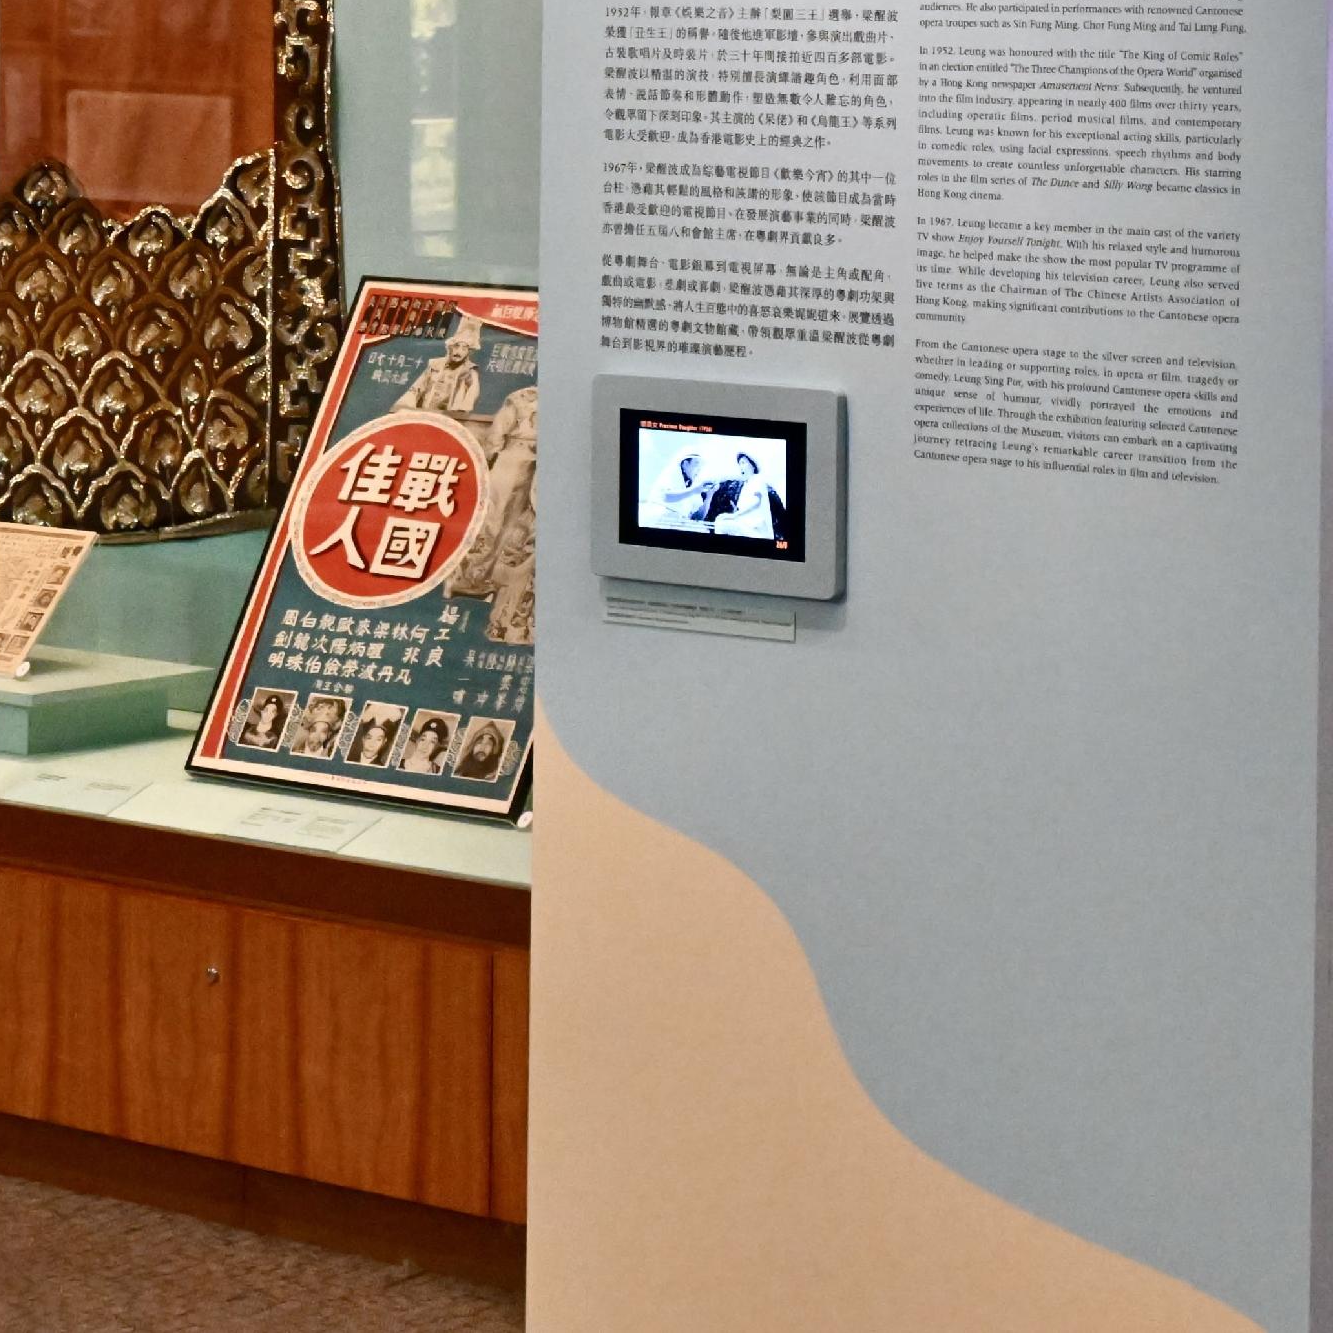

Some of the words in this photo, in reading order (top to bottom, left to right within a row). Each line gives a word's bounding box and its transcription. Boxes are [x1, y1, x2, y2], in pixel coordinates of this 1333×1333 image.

[919, 43, 928, 56] In
[958, 44, 986, 59] Leung
[988, 47, 1005, 57] was
[1008, 45, 1053, 58] honoured
[1056, 45, 1077, 58] with
[1079, 46, 1095, 59] the
[1098, 46, 1115, 59] title
[1143, 47, 1164, 62] King
[1167, 47, 1177, 60] of
[1180, 47, 1210, 60] Comic
[918, 91, 936, 104] into
[938, 91, 953, 104] the
[955, 92, 973, 105] film
[1017, 94, 1062, 110] appearing
[1065, 95, 1074, 108] in
[1077, 95, 1106, 111] nearly
[1108, 96, 1126, 109] 400
[1129, 97, 1152, 110] films
[1154, 101, 1176, 110] over
[1179, 98, 1207, 114] thirty
[917, 229, 929, 242] TV
[931, 230, 955, 243] show
[957, 231, 984, 247] Enjoy
[987, 232, 1024, 247] Yourself
[1066, 236, 1088, 250] With
[1091, 238, 1105, 251] his
[1108, 239, 1142, 253] relaxed
[1145, 240, 1167, 257] style
[1169, 242, 1187, 255] and
[915, 277, 932, 290] five
[936, 278, 963, 292] terms
[966, 282, 976, 292] as
[980, 280, 995, 293] the
[999, 281, 1047, 296] Chairman
[1051, 284, 1061, 297] of
[1064, 285, 1082, 298] The
[1087, 286, 1126, 301] Chinese
[1130, 288, 1162, 303] Artists
[1167, 290, 1224, 306] Association
[1229, 294, 1239, 307] of
[915, 336, 939, 350] From
[942, 338, 957, 351] the
[961, 339, 1009, 355] Cantonese
[1012, 345, 1038, 359] opera
[1042, 345, 1066, 361] stage
[1069, 347, 1078, 360] to
[1082, 347, 1098, 361] the
[1101, 349, 1128, 363] silver
[1131, 353, 1162, 365] screen
[1165, 353, 1184, 367] and
[913, 434, 950, 449] journey
[955, 434, 997, 452] retracing
[1043, 441, 1098, 458] remarkable
[1103, 449, 1133, 460] career
[1138, 448, 1186, 465] transition
[1191, 453, 1215, 467] from
[1220, 455, 1237, 469] the
